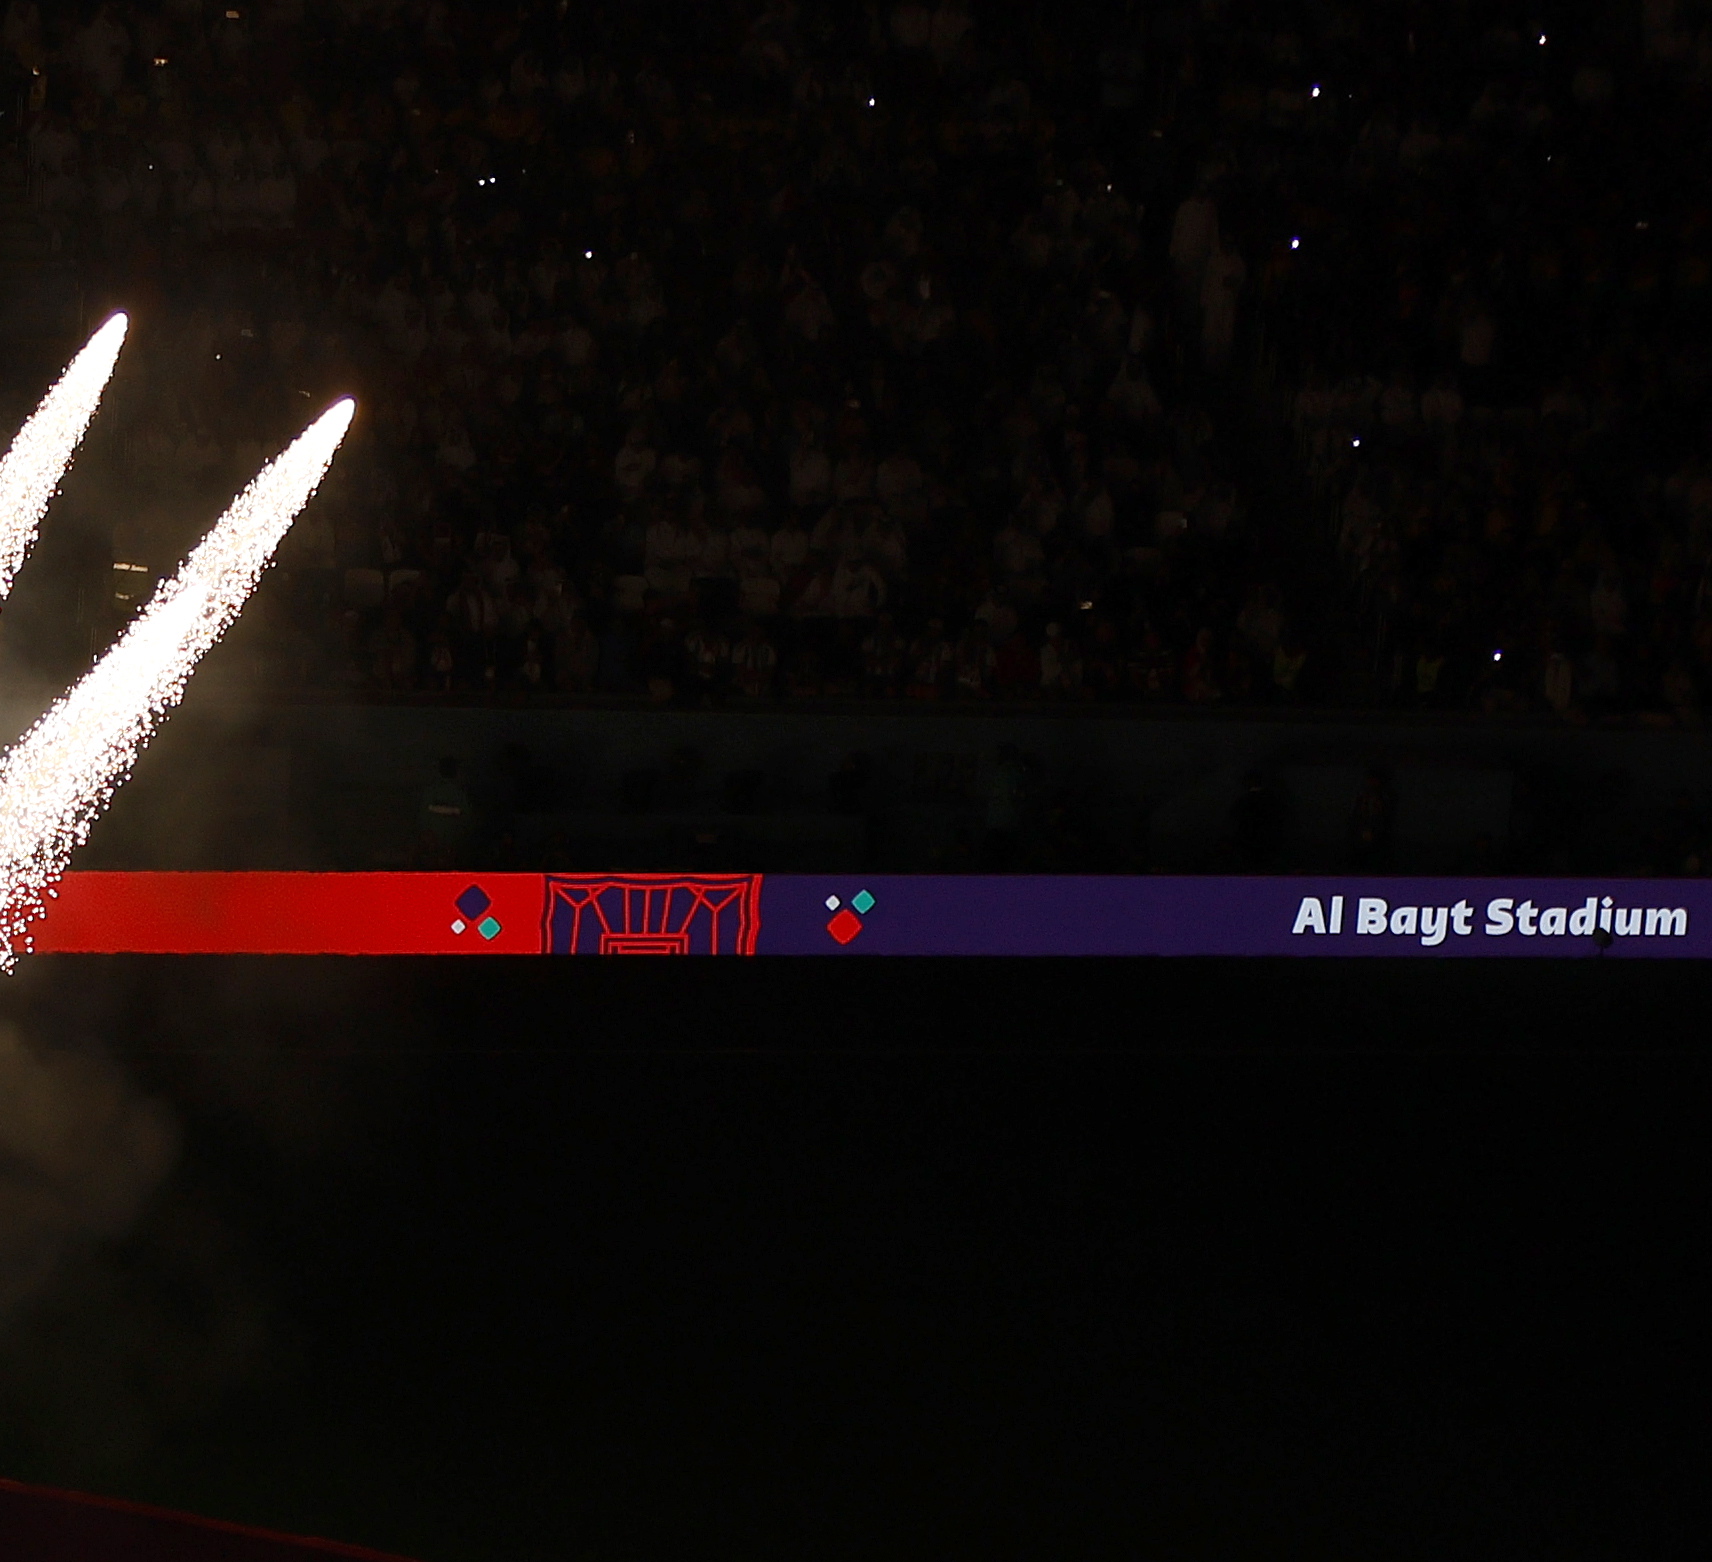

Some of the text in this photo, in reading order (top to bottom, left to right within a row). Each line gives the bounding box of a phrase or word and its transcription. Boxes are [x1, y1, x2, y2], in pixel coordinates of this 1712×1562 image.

[1292, 895, 1688, 946] Al Bayt Stadium
